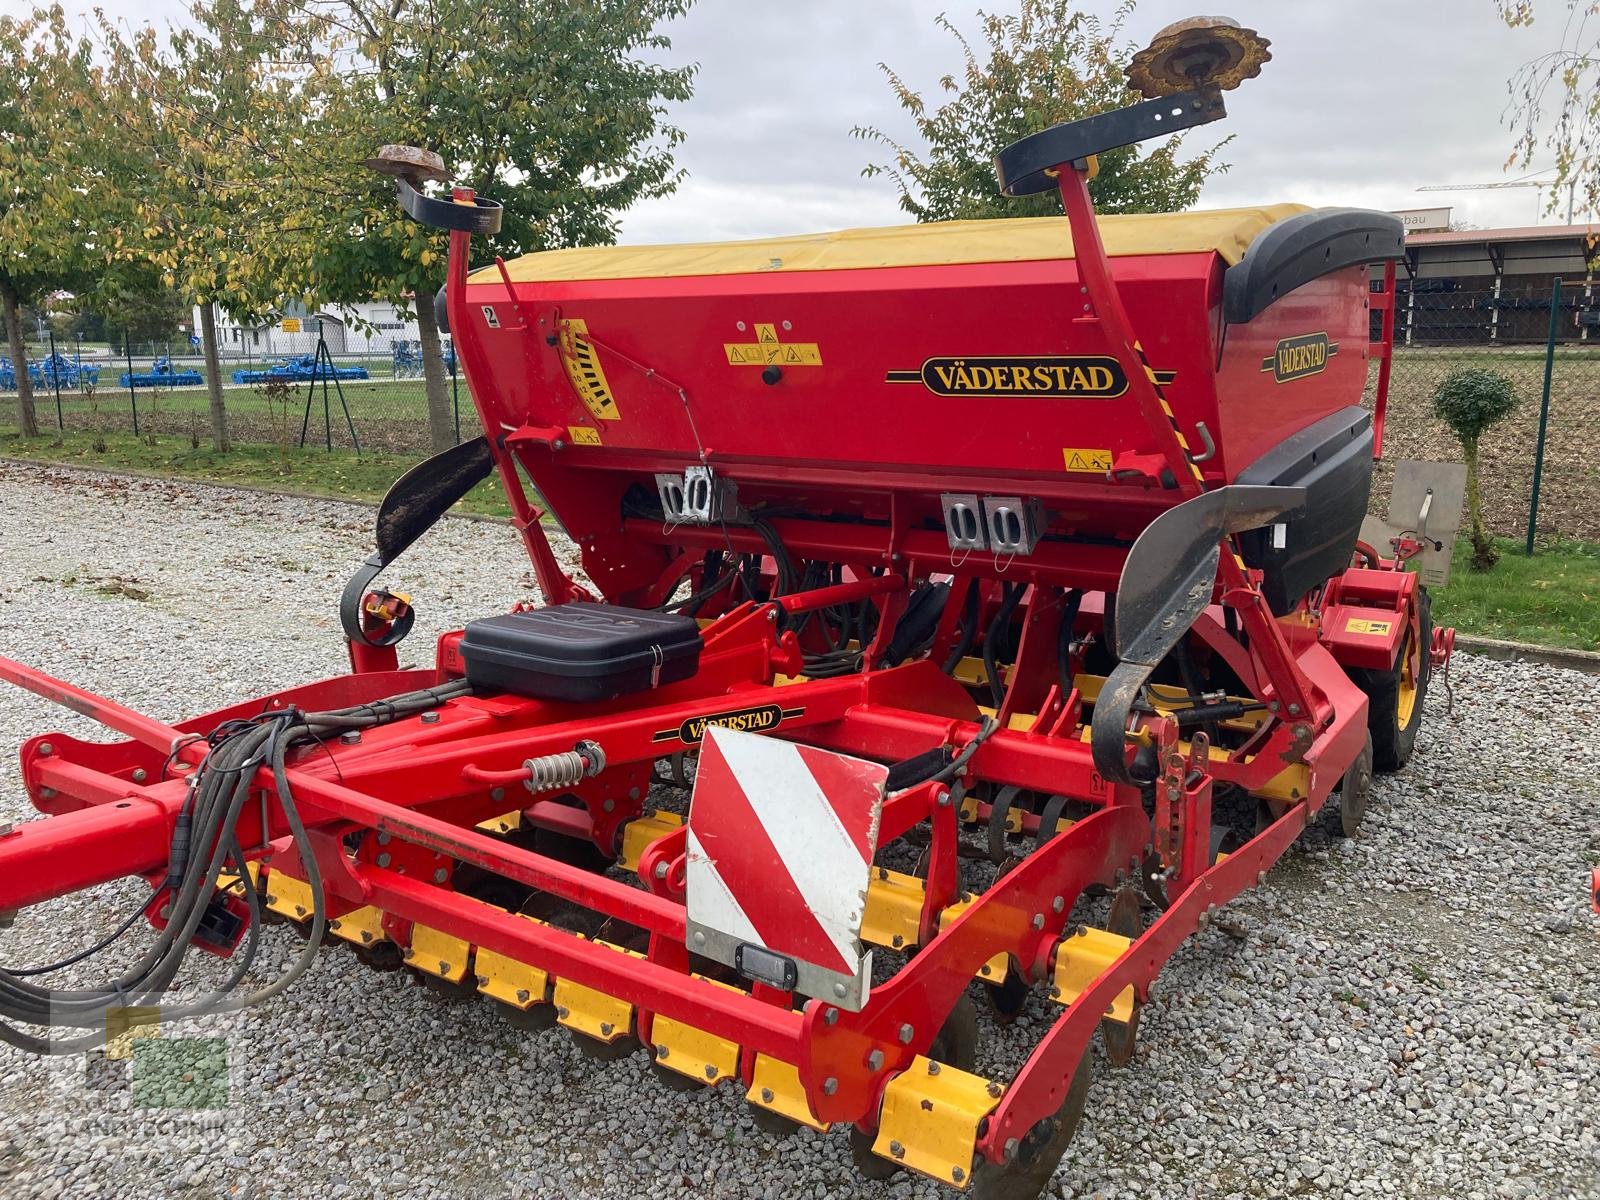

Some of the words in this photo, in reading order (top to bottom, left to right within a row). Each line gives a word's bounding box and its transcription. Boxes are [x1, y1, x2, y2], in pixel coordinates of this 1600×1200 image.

[485, 307, 497, 323] 2
[1279, 343, 1325, 374] VÄDERSTAD
[934, 361, 1113, 391] VÄDERSTAD
